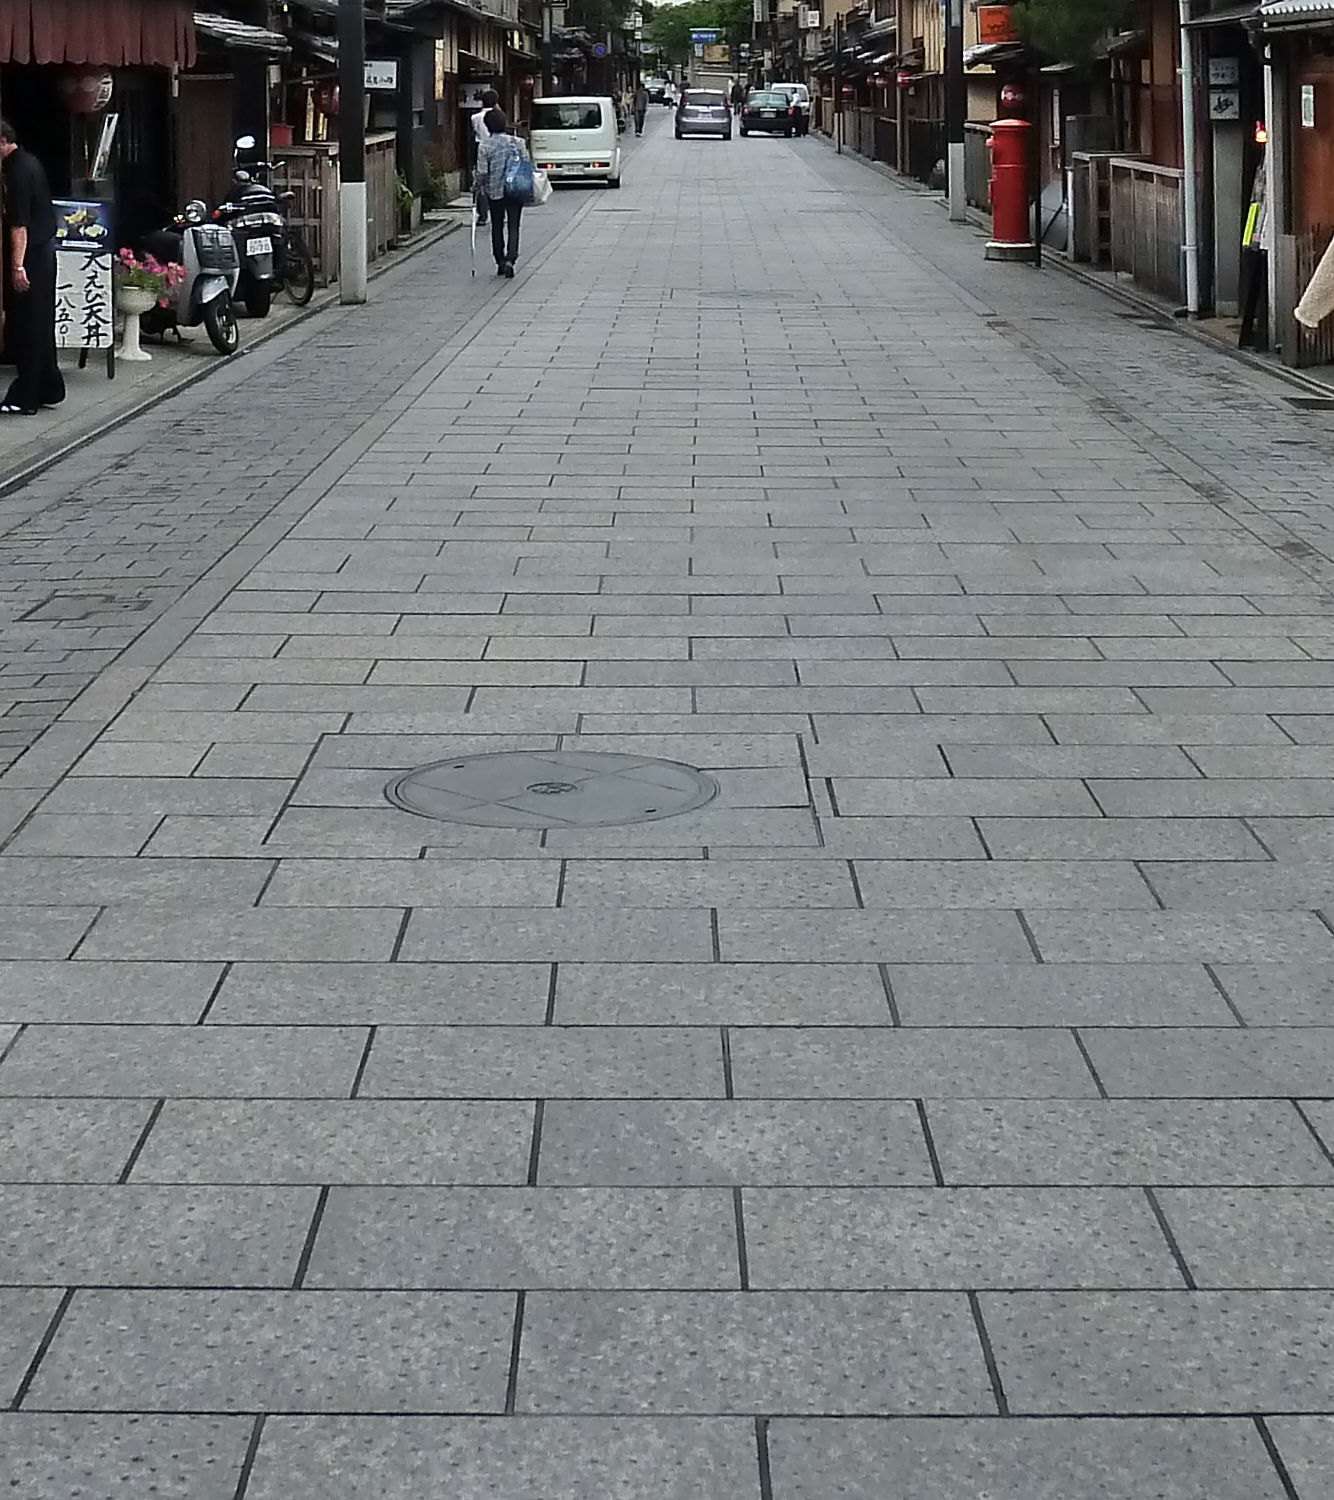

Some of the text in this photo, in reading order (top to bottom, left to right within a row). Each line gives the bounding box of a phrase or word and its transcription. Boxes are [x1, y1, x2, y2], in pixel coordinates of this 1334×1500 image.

[80, 252, 111, 348] 大えび天丼
